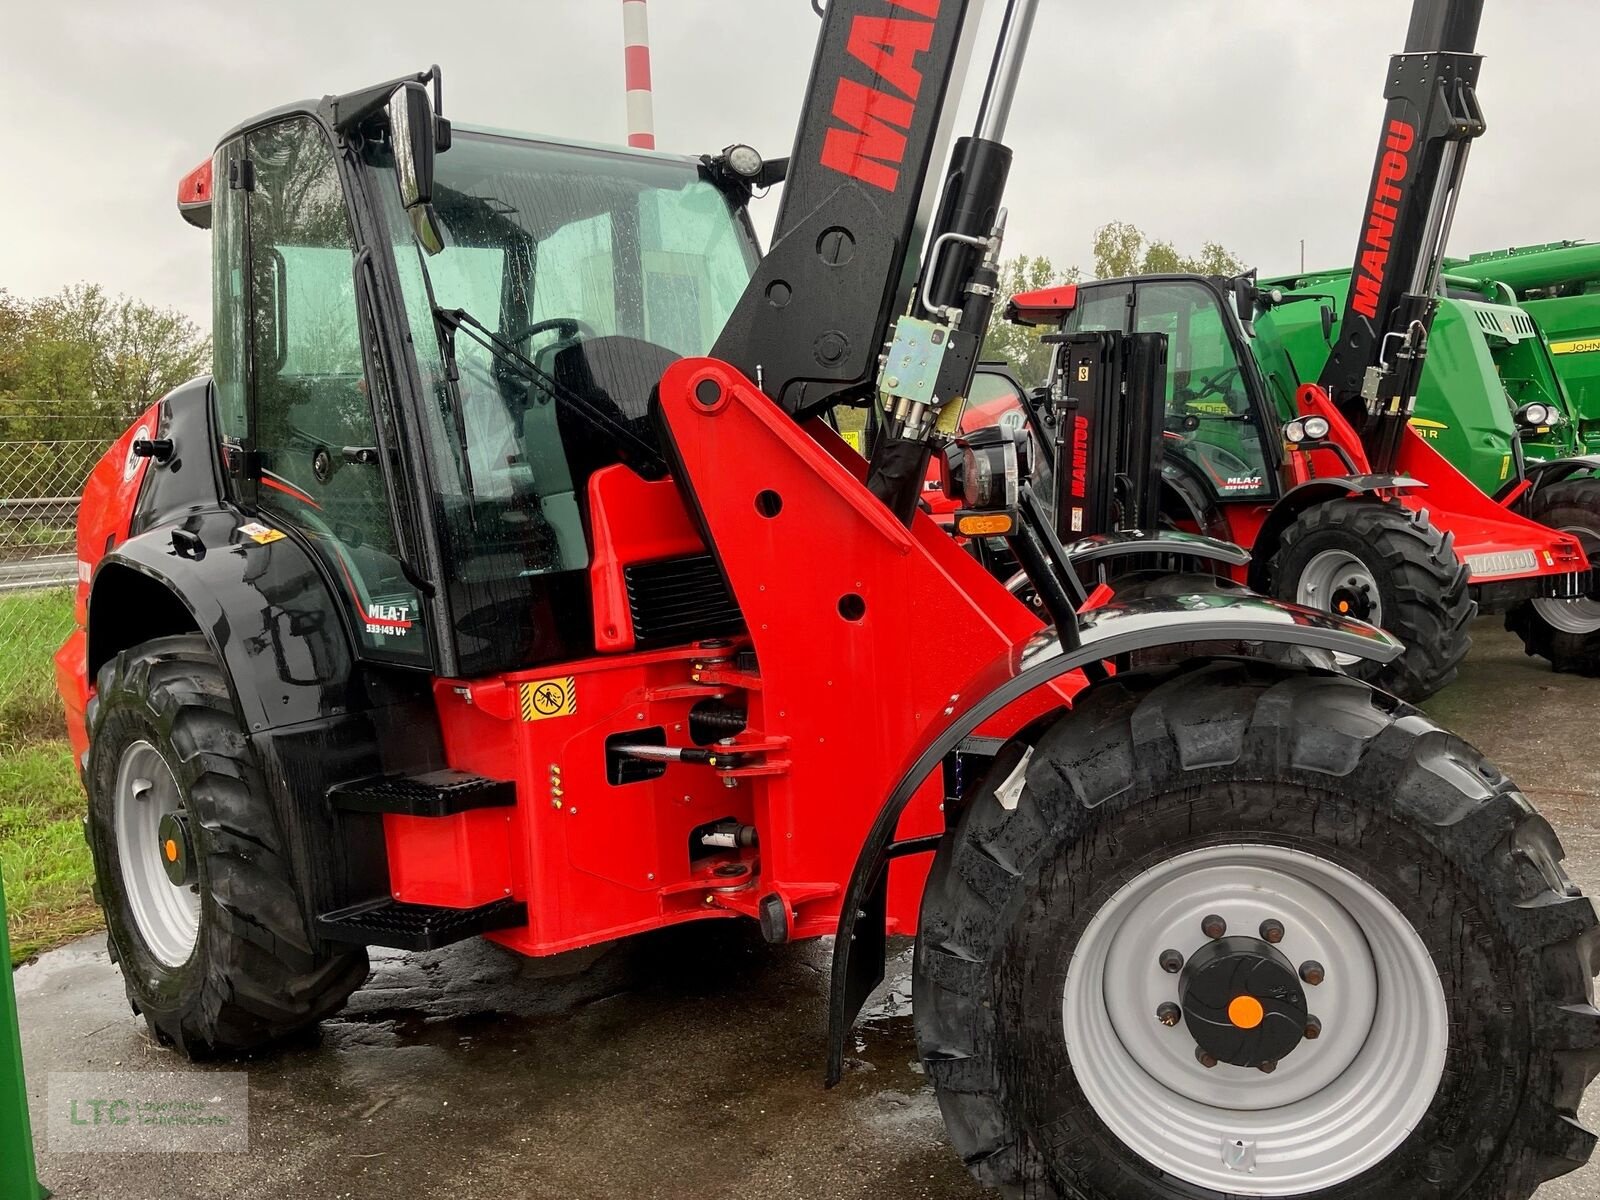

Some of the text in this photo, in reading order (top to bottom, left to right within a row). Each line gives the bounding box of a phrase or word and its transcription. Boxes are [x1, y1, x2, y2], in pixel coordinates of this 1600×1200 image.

[1352, 120, 1415, 318] MANITOU
[1072, 416, 1088, 497] MANITOU
[1467, 552, 1536, 573] MANITOU
